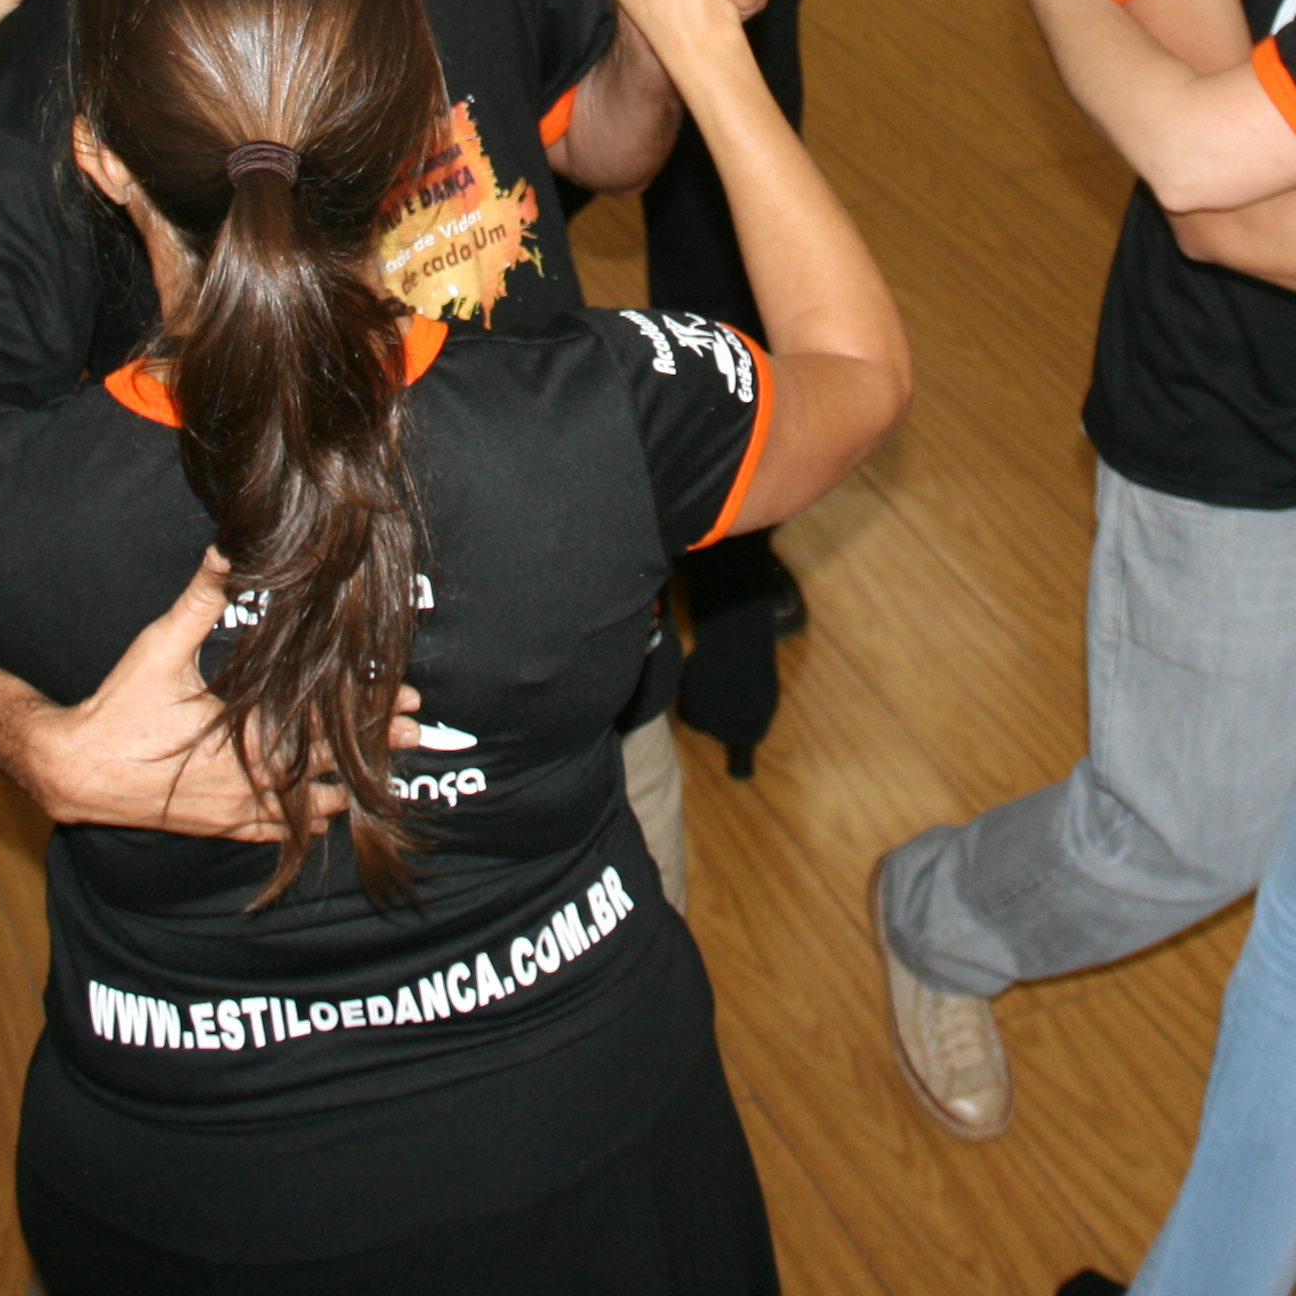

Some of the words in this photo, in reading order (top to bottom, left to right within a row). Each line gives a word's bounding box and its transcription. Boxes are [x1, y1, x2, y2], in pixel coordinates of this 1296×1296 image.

[422, 241, 473, 277] cada
[472, 222, 507, 251] Um
[437, 209, 483, 239] Vida:
[88, 864, 636, 1052] WWW.ESTILOEDANCA.COM.BR
